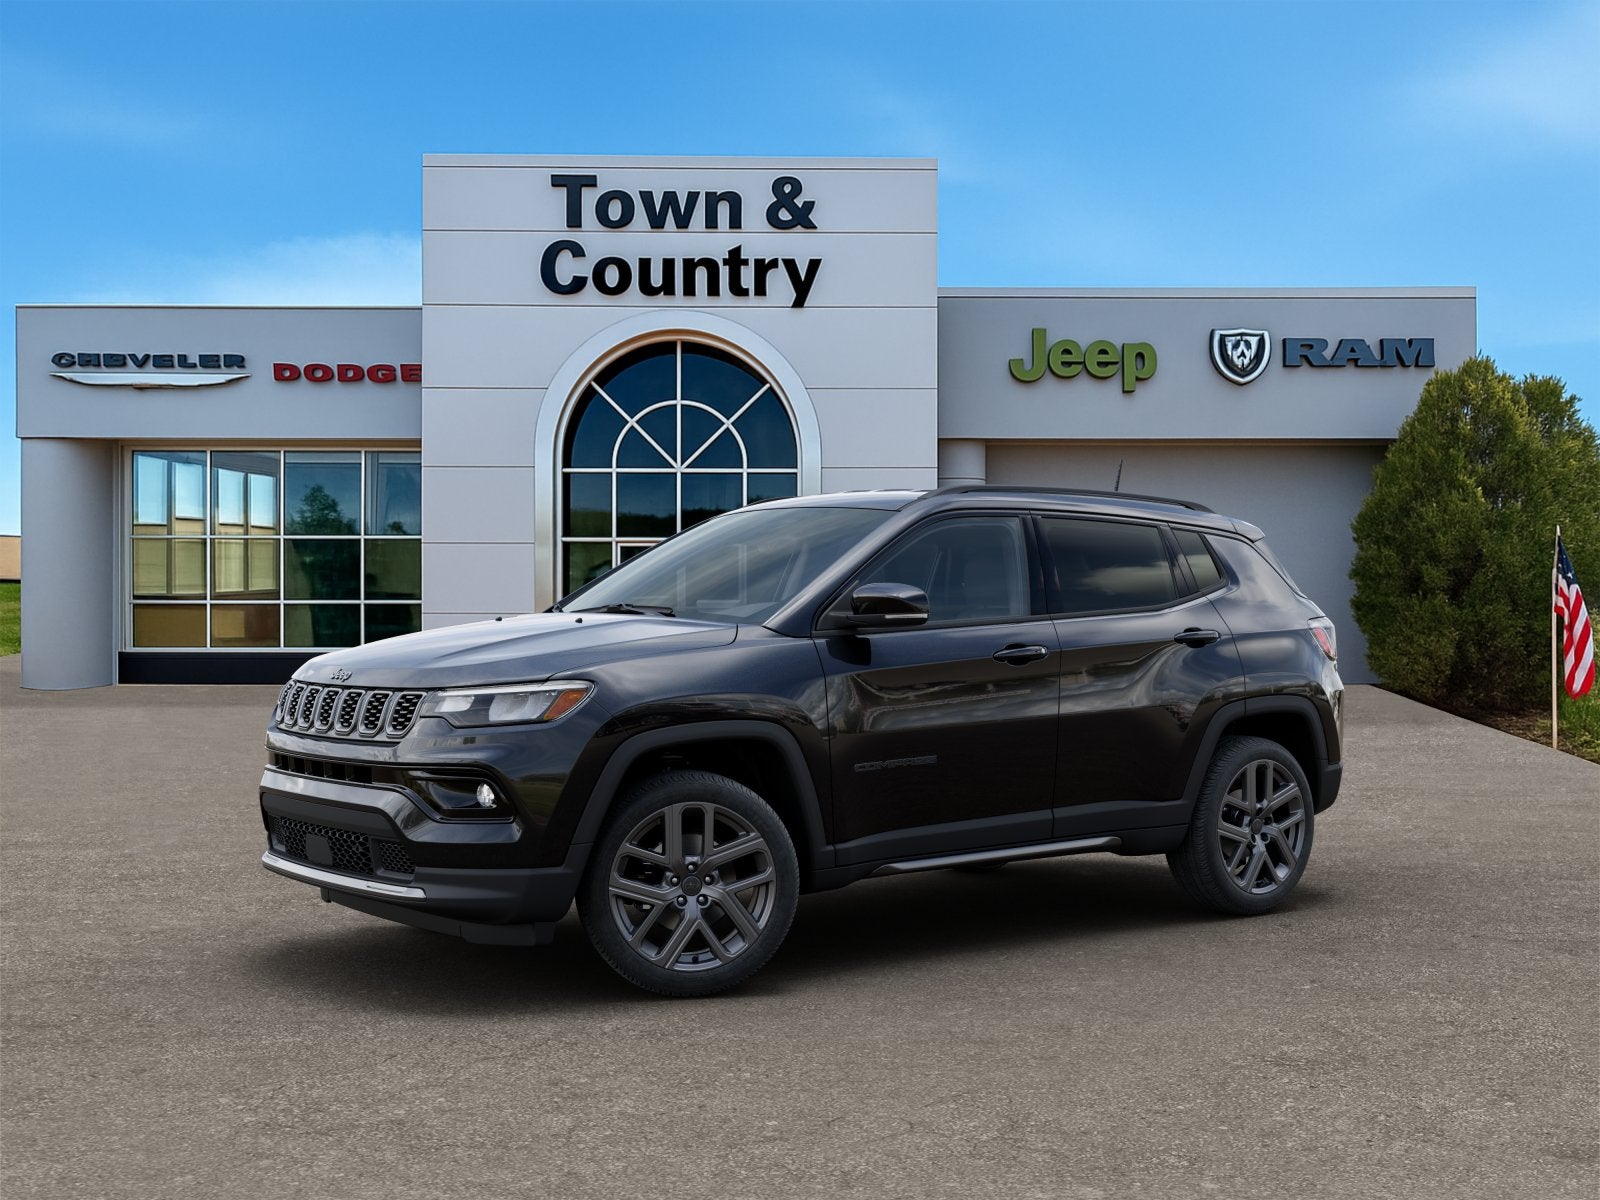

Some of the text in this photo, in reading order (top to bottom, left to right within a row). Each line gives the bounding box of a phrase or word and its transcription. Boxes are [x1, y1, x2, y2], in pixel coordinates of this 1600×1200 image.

[550, 174, 818, 230] Town &
[540, 239, 822, 308] Country
[273, 363, 422, 384] DODGE
[1009, 328, 1158, 393] Jeep
[1282, 337, 1435, 368] RAM
